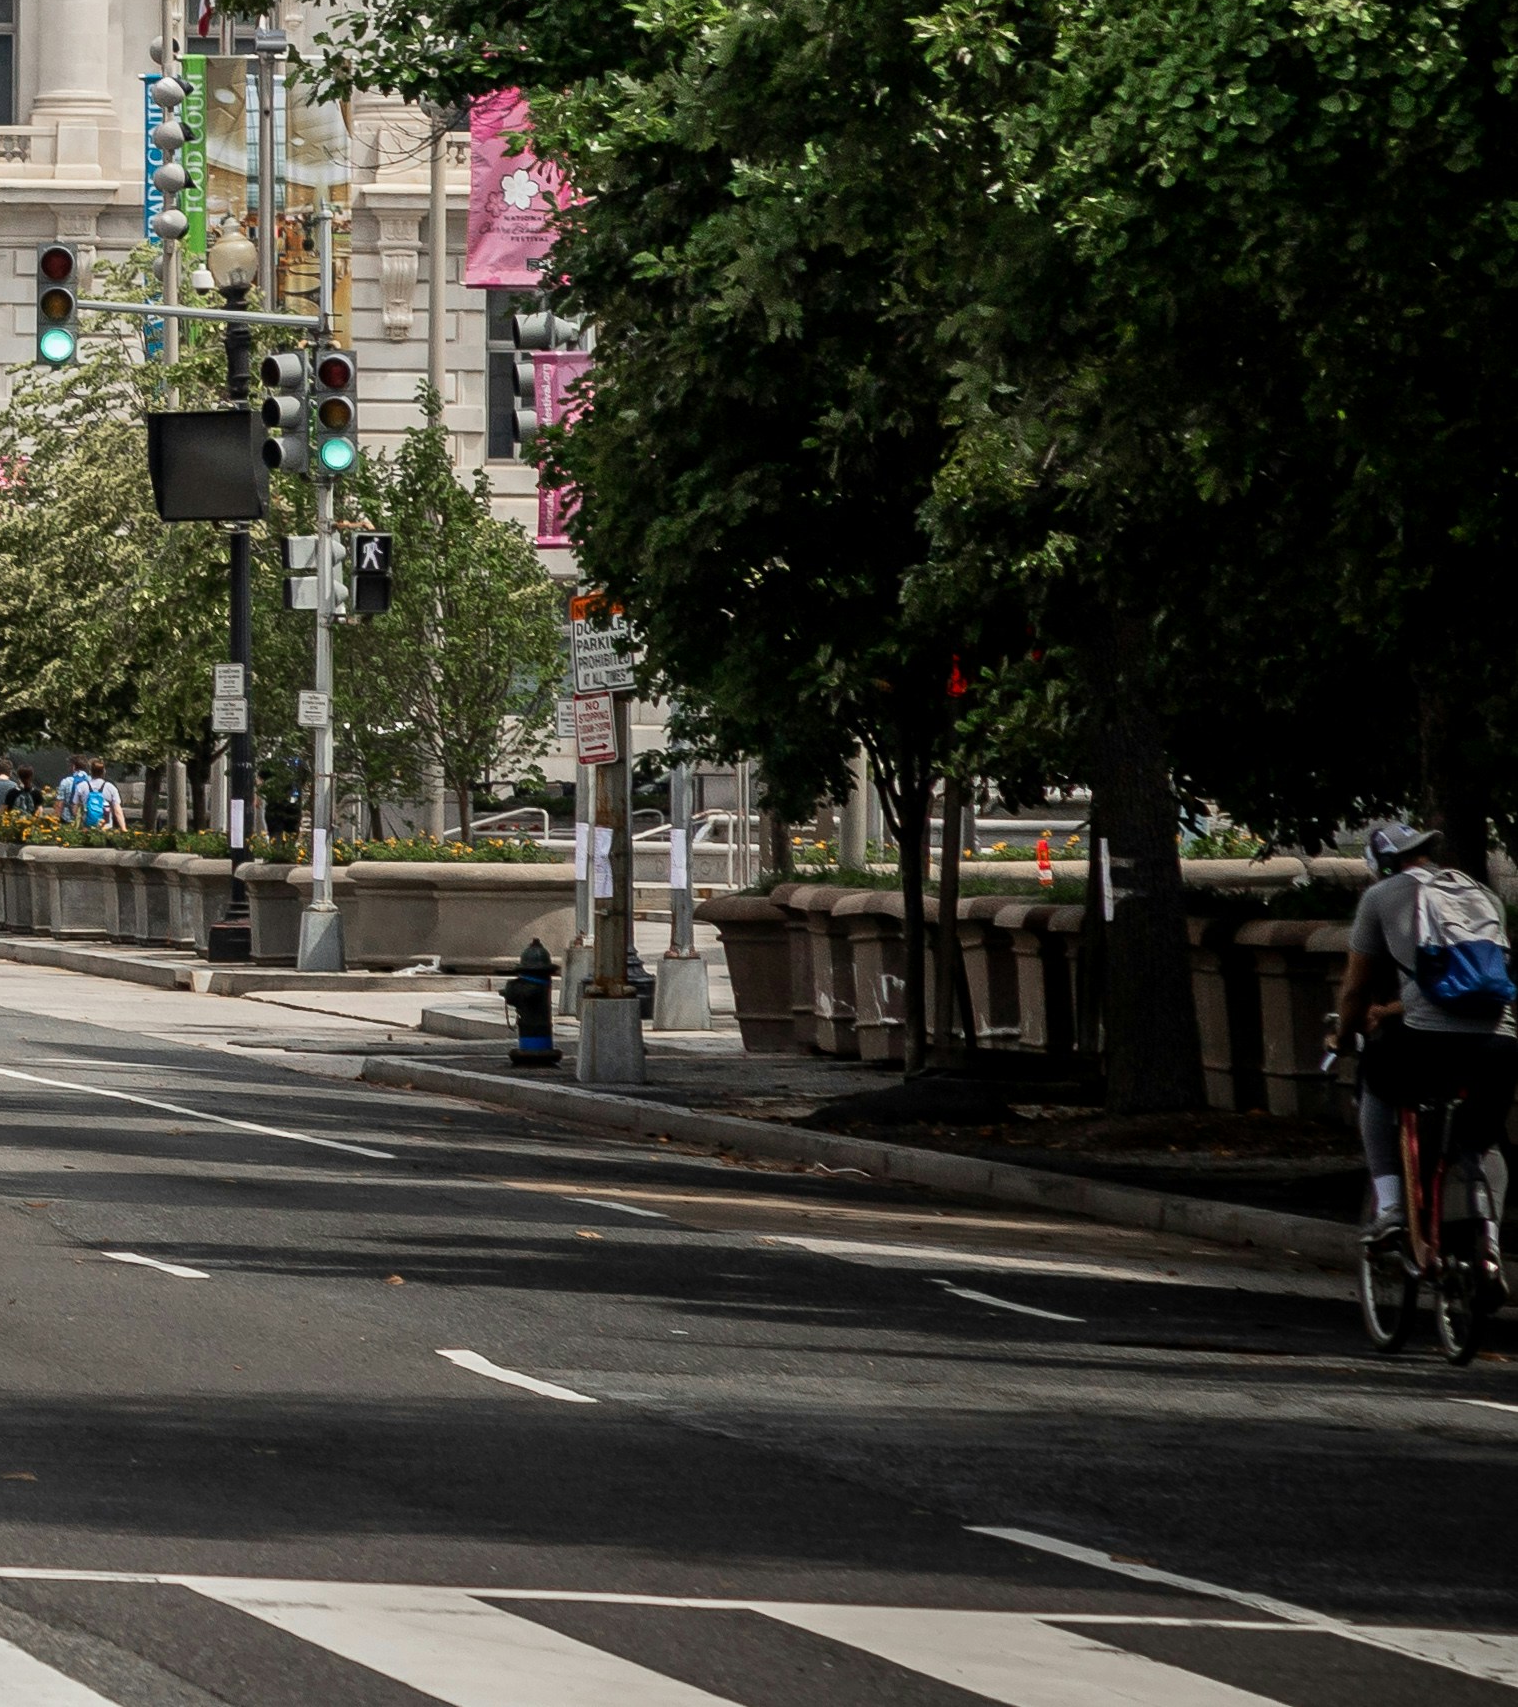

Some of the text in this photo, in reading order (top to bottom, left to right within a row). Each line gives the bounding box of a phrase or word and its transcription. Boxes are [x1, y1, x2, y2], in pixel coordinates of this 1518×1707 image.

[186, 74, 203, 212] FOOD COURT
[576, 616, 626, 637] DOLE
[578, 653, 630, 671] PROHIBITED
[591, 672, 603, 685] ALL
[603, 668, 627, 684] TIMES
[585, 700, 600, 711] NO
[579, 711, 610, 724] STOPPING
